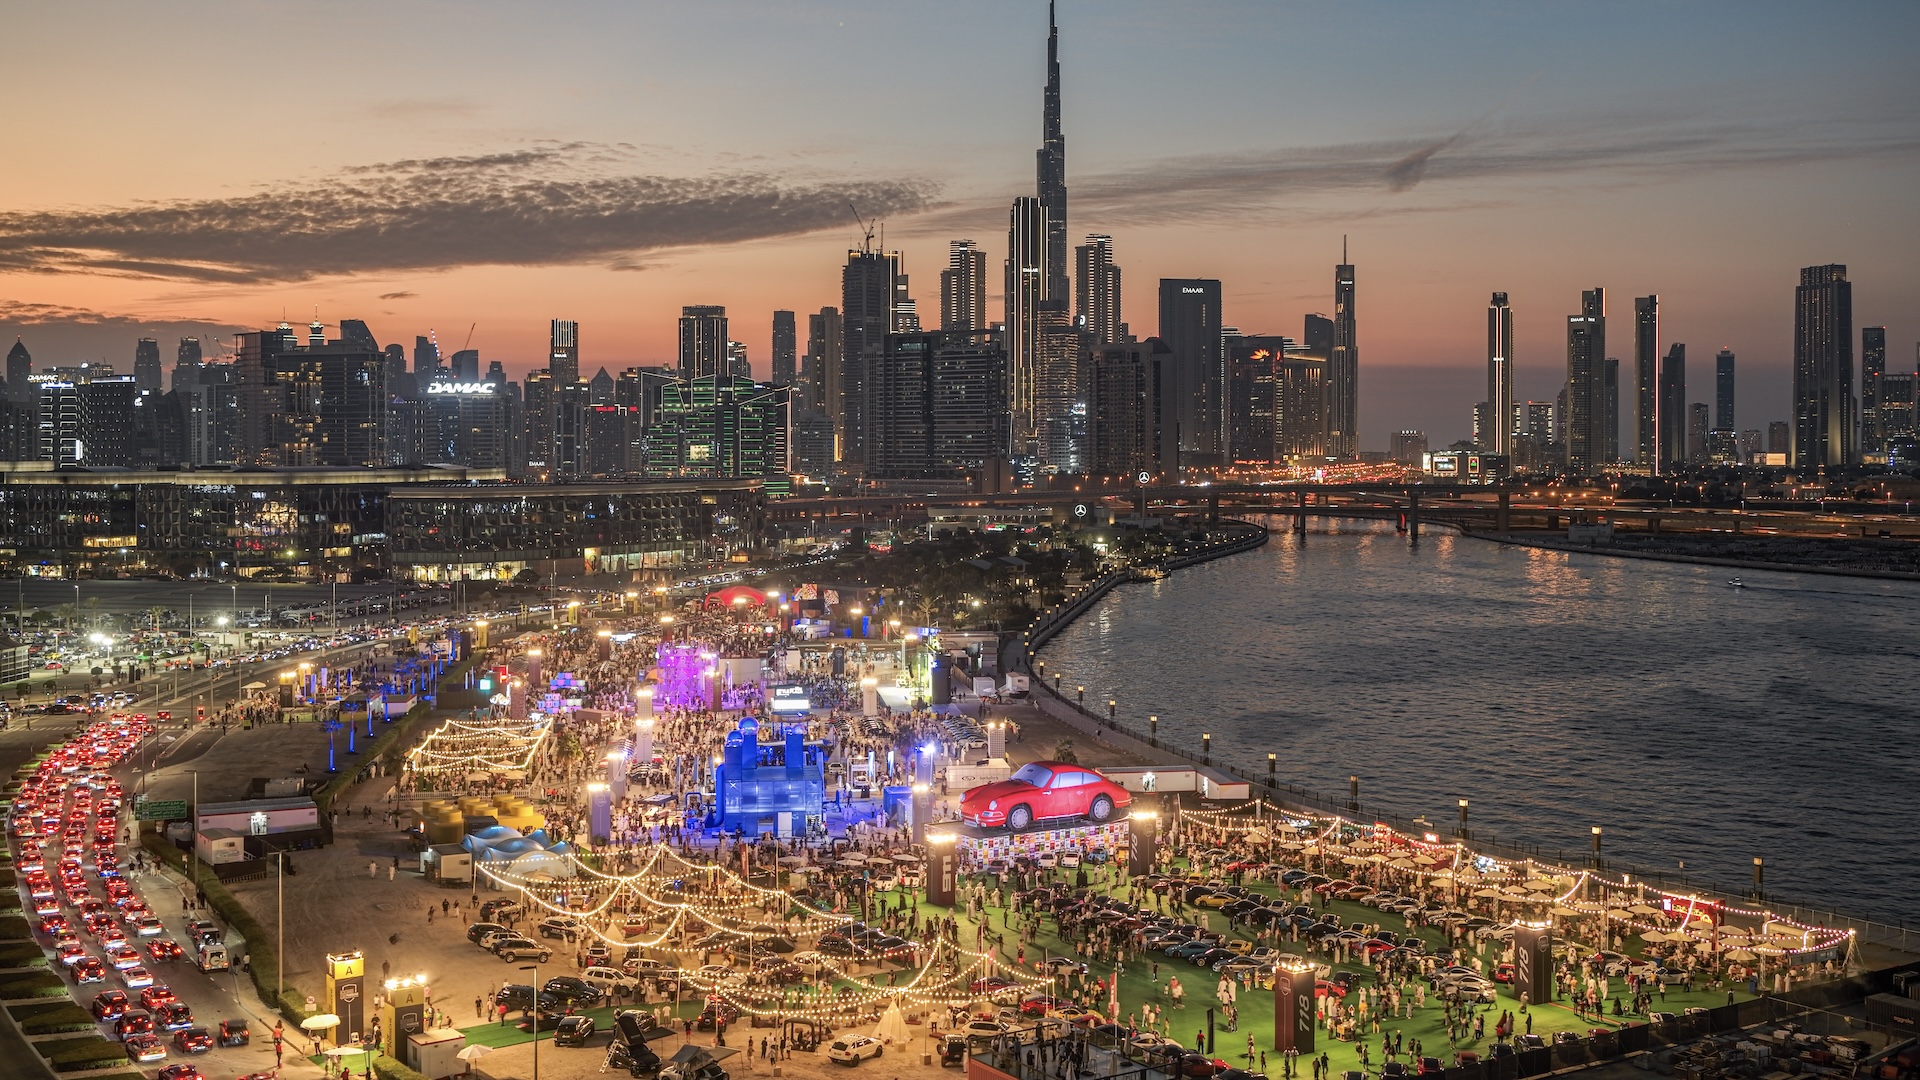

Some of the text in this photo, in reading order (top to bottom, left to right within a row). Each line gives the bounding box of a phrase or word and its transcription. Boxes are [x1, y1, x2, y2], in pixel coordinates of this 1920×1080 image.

[427, 382, 496, 394] DAMAC
[345, 966, 353, 976] A
[1519, 946, 1529, 984] 718
[405, 993, 414, 1004] A
[1298, 994, 1310, 1032] 718
